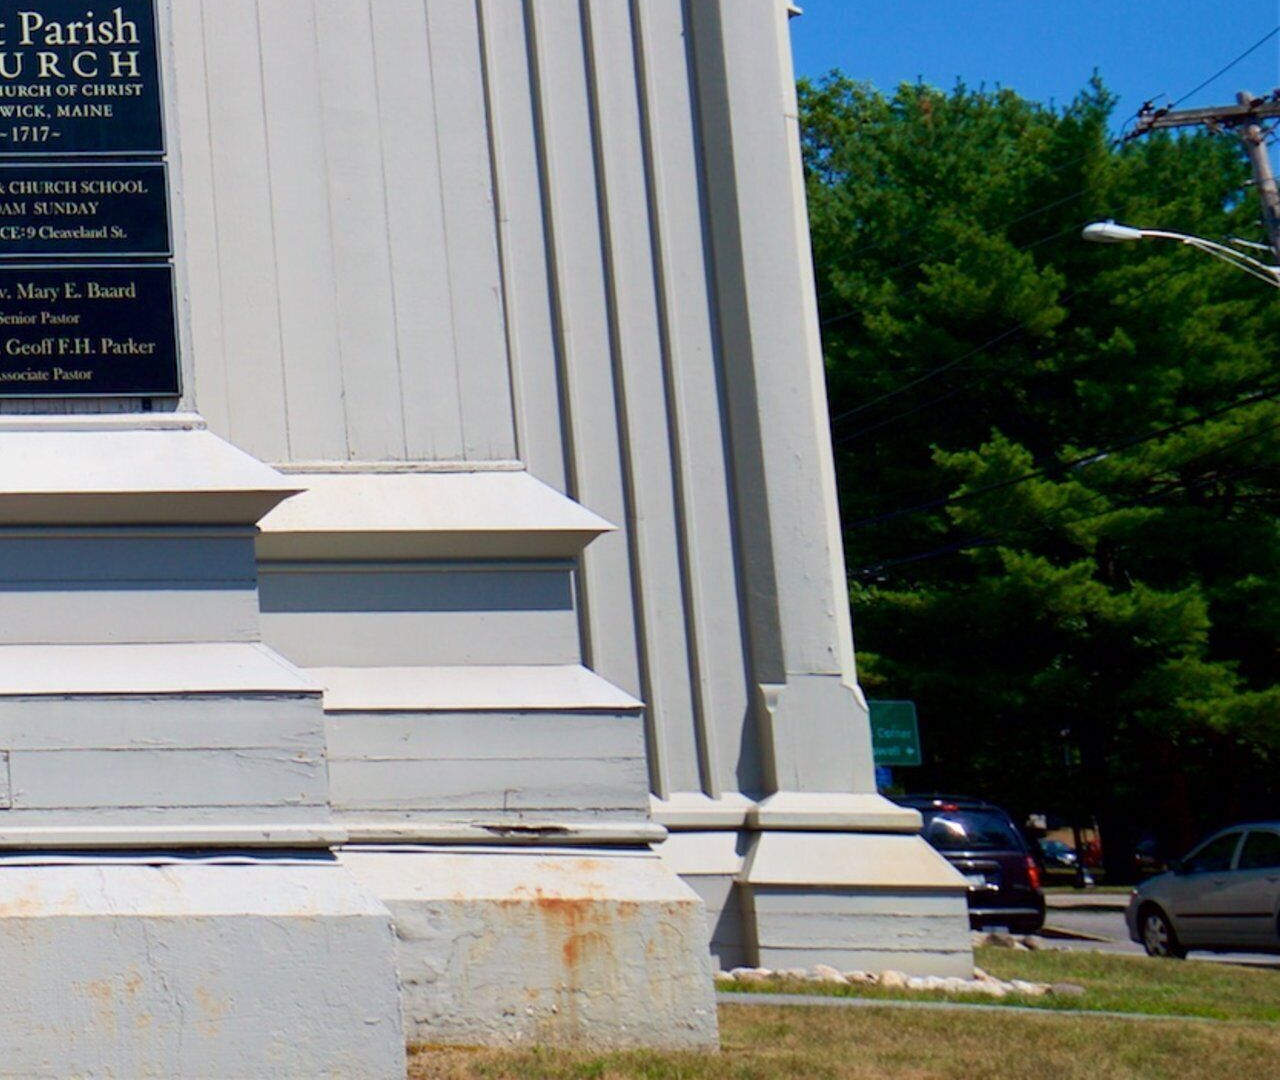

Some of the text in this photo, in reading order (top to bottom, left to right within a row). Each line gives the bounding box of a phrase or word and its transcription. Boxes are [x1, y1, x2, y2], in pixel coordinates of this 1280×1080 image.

[17, 6, 140, 45] Parish
[55, 84, 78, 97] OF
[81, 83, 144, 97] CHRIST
[56, 104, 113, 117] MAINE
[8, 180, 77, 195] CHURCH
[80, 180, 149, 194] SCHOOL
[33, 201, 99, 215] SUNDAY
[38, 225, 108, 240] Cleaveland
[110, 225, 128, 239] St.
[16, 282, 60, 302] Mary
[64, 282, 82, 299] E.
[87, 281, 137, 299] Baard
[40, 311, 81, 325] Pastor
[5, 337, 55, 355] Geoff
[58, 337, 96, 355] F.H.
[101, 337, 156, 355] Parker
[53, 367, 93, 381] Pastor
